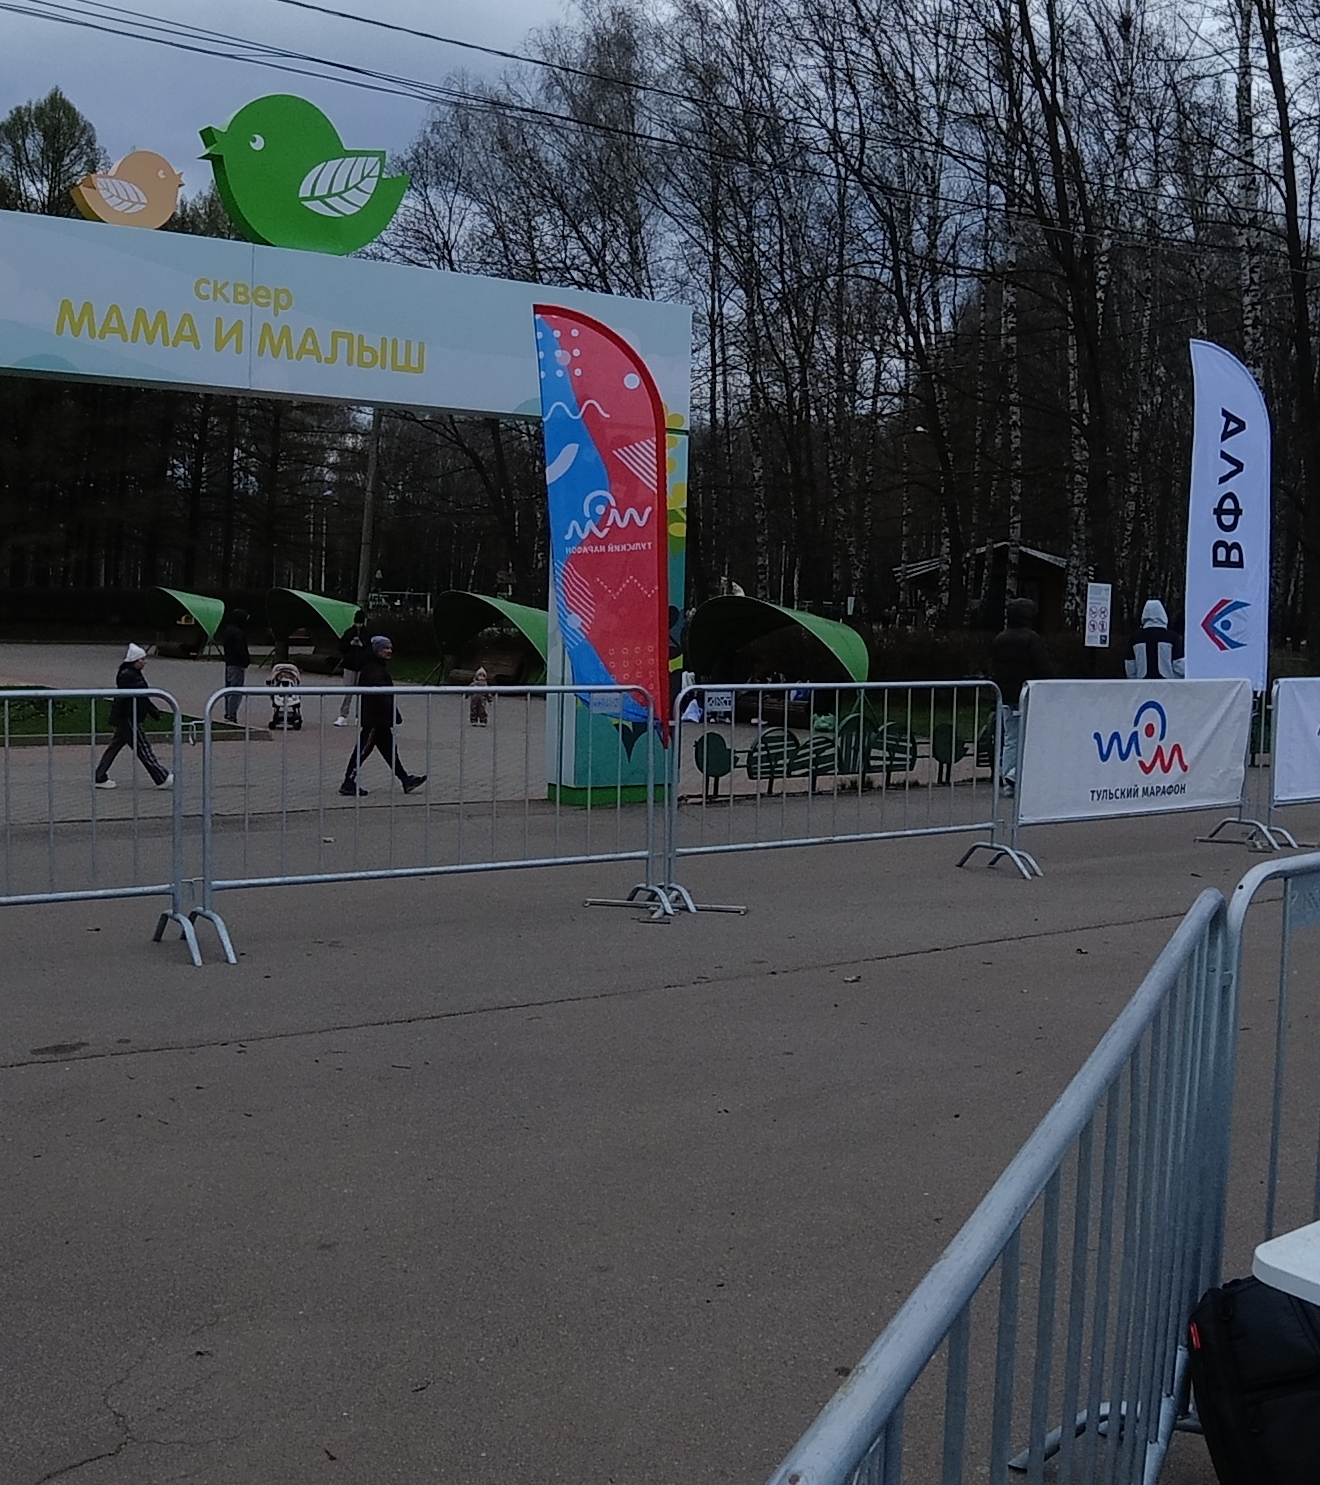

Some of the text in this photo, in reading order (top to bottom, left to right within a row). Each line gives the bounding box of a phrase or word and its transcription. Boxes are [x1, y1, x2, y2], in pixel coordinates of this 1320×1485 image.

[194, 277, 293, 316] сквер
[56, 298, 426, 374] МАМА И МАЛЫШ
[1090, 783, 1187, 801] ТУЛЬСКИЙ МАРАФОН
